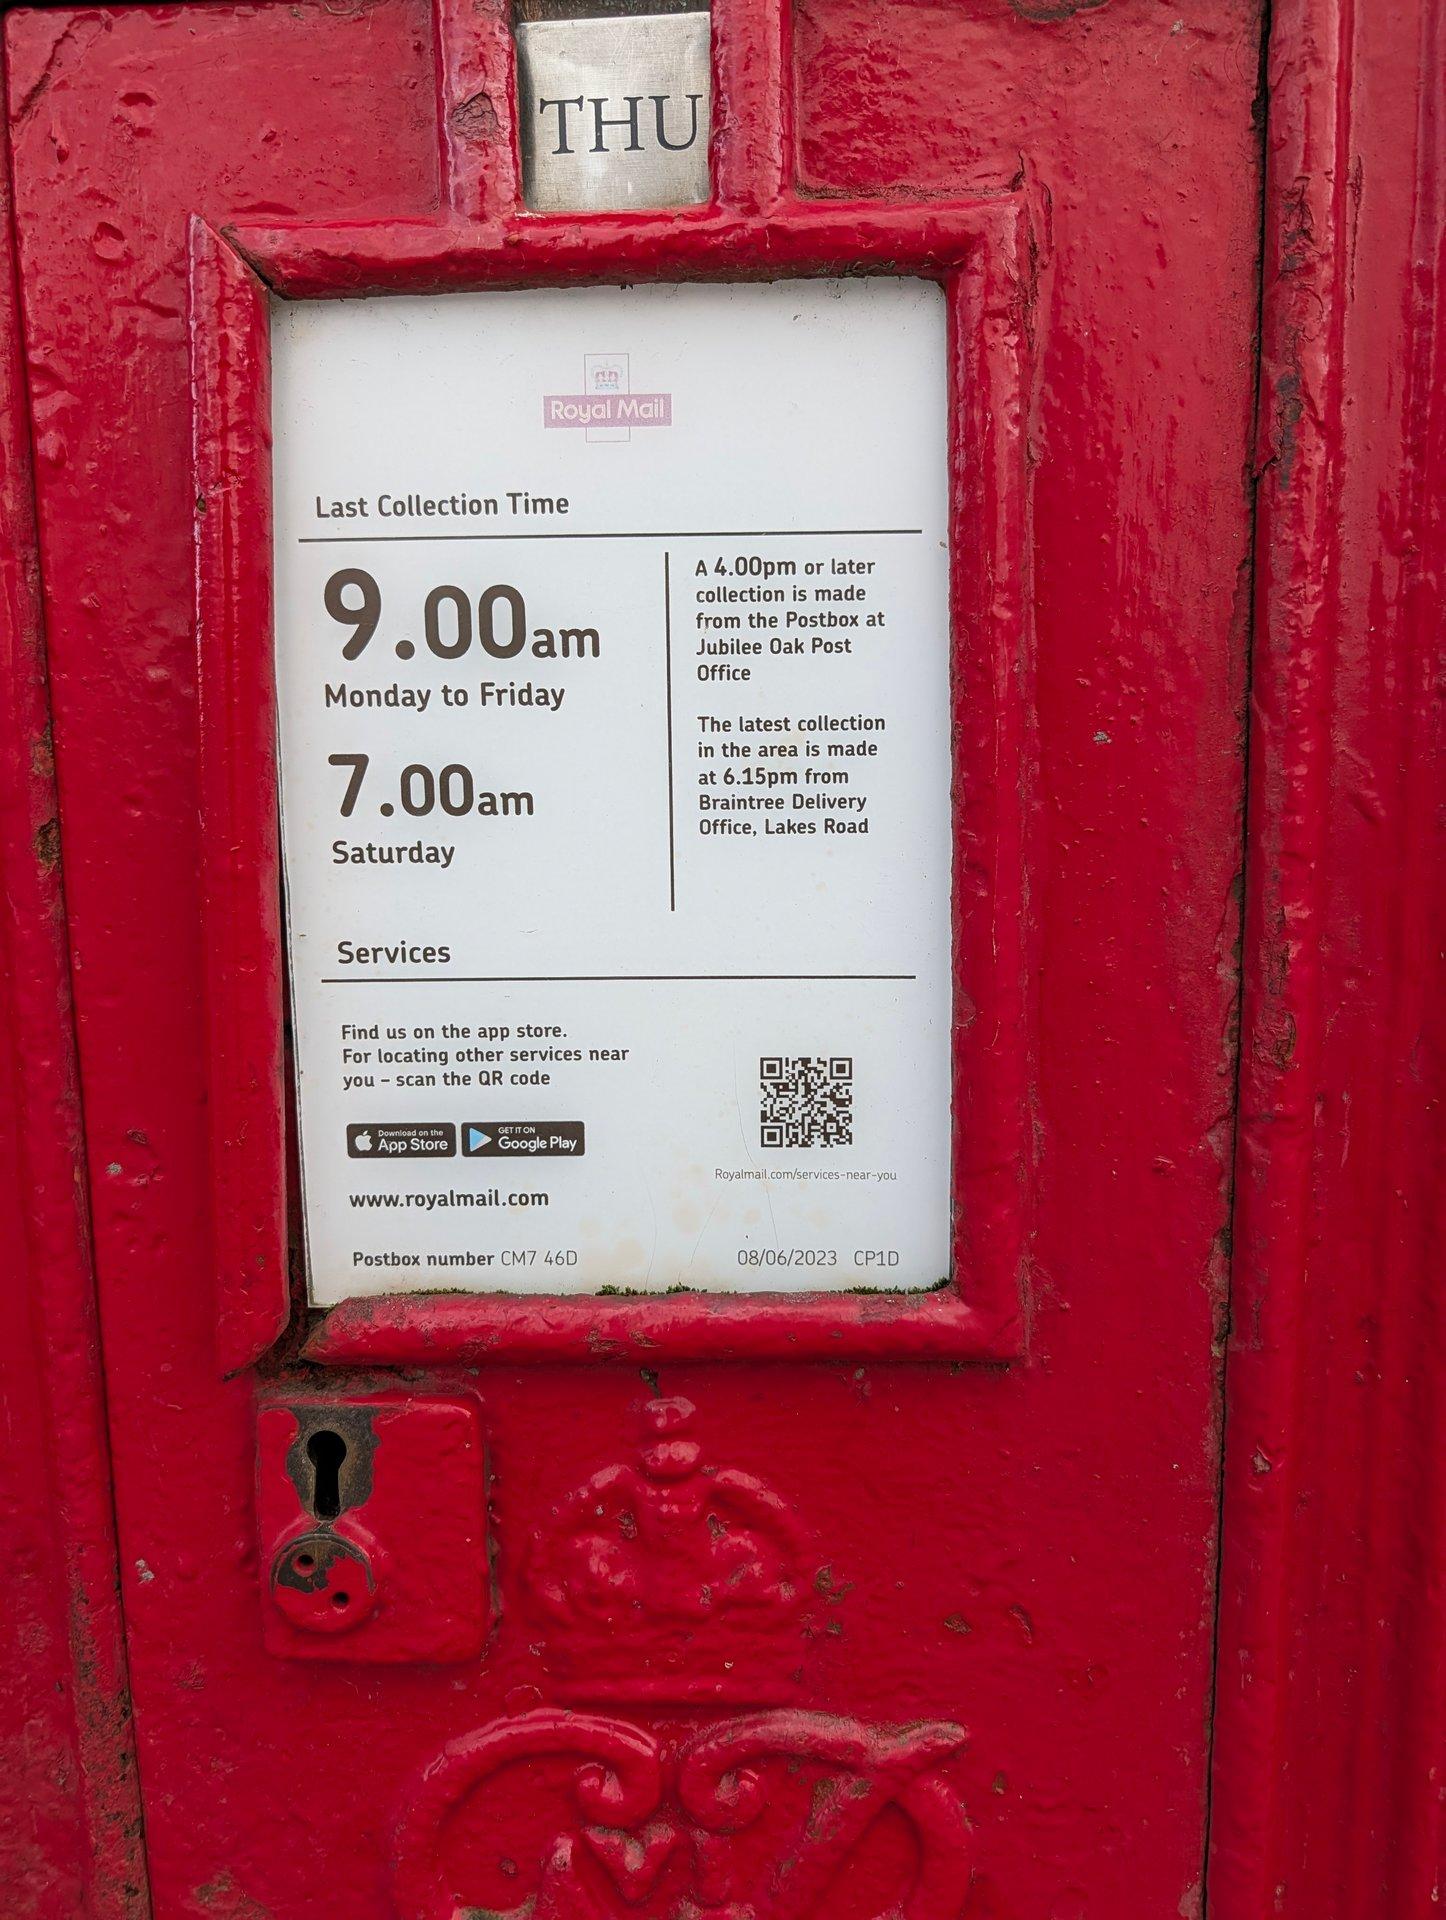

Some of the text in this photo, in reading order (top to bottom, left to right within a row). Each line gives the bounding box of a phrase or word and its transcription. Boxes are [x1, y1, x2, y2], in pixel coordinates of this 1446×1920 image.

[540, 94, 706, 154] THU
[551, 398, 665, 424] Royal Mail
[317, 492, 569, 518] Last Collection Time
[695, 556, 875, 580] A 4.00pm or later
[697, 585, 865, 603] collection is made
[324, 568, 600, 661] 9.00am
[696, 611, 885, 629] from the Postbox at
[696, 637, 852, 655] Jubilee Oak Post
[698, 664, 750, 681] Office
[325, 682, 565, 712] Monday to Friday
[699, 714, 885, 732] The latest collection
[698, 740, 877, 757] in the area is made
[328, 754, 533, 817] 7.00am
[699, 767, 848, 788] at 6.15pm from
[700, 793, 866, 812] Braintree Delivery
[700, 818, 868, 836] Office, Lakes Road
[333, 841, 455, 868] Saturday
[338, 940, 450, 964] Services
[342, 1024, 567, 1041] Find us on the app store.
[343, 1046, 629, 1066] For locating other services near
[343, 1076, 374, 1090] you
[397, 1075, 435, 1086] scan
[443, 1071, 471, 1086] the
[479, 1071, 503, 1086] QR
[510, 1070, 550, 1085] code
[378, 1129, 417, 1137] Download
[378, 1138, 448, 1153] App Store
[498, 1136, 577, 1152] Google Play
[716, 1168, 896, 1182] Royalmail.com/services-near-you
[349, 1189, 548, 1210] www.royalmail.com
[353, 1250, 577, 1266] Postbox number CM7 46D
[738, 1249, 899, 1266] 08/06/2023 CP1D
